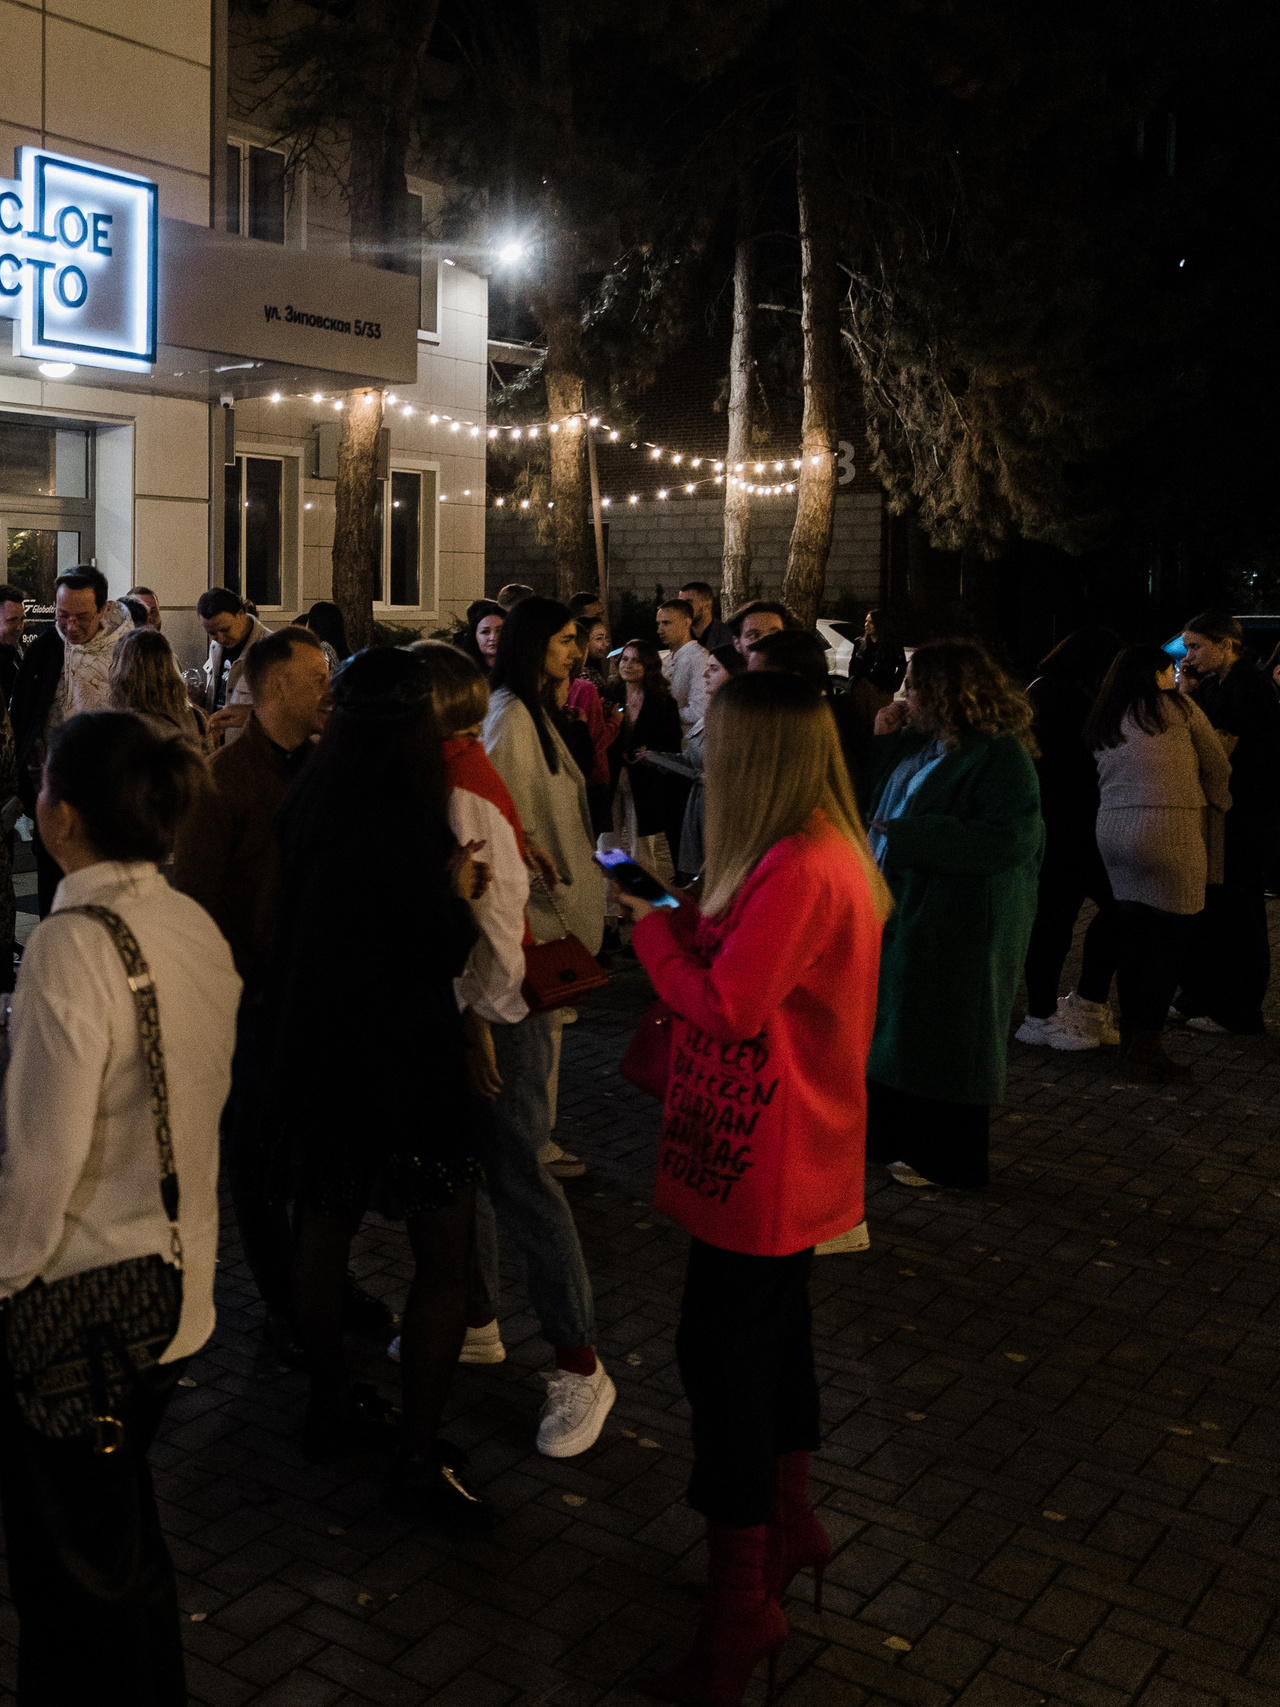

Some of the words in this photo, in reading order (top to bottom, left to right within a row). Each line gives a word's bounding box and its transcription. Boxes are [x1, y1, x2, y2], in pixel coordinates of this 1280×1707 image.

[264, 305, 281, 322] ул.
[285, 305, 351, 334] Зиповская
[354, 319, 381, 339] 5/33
